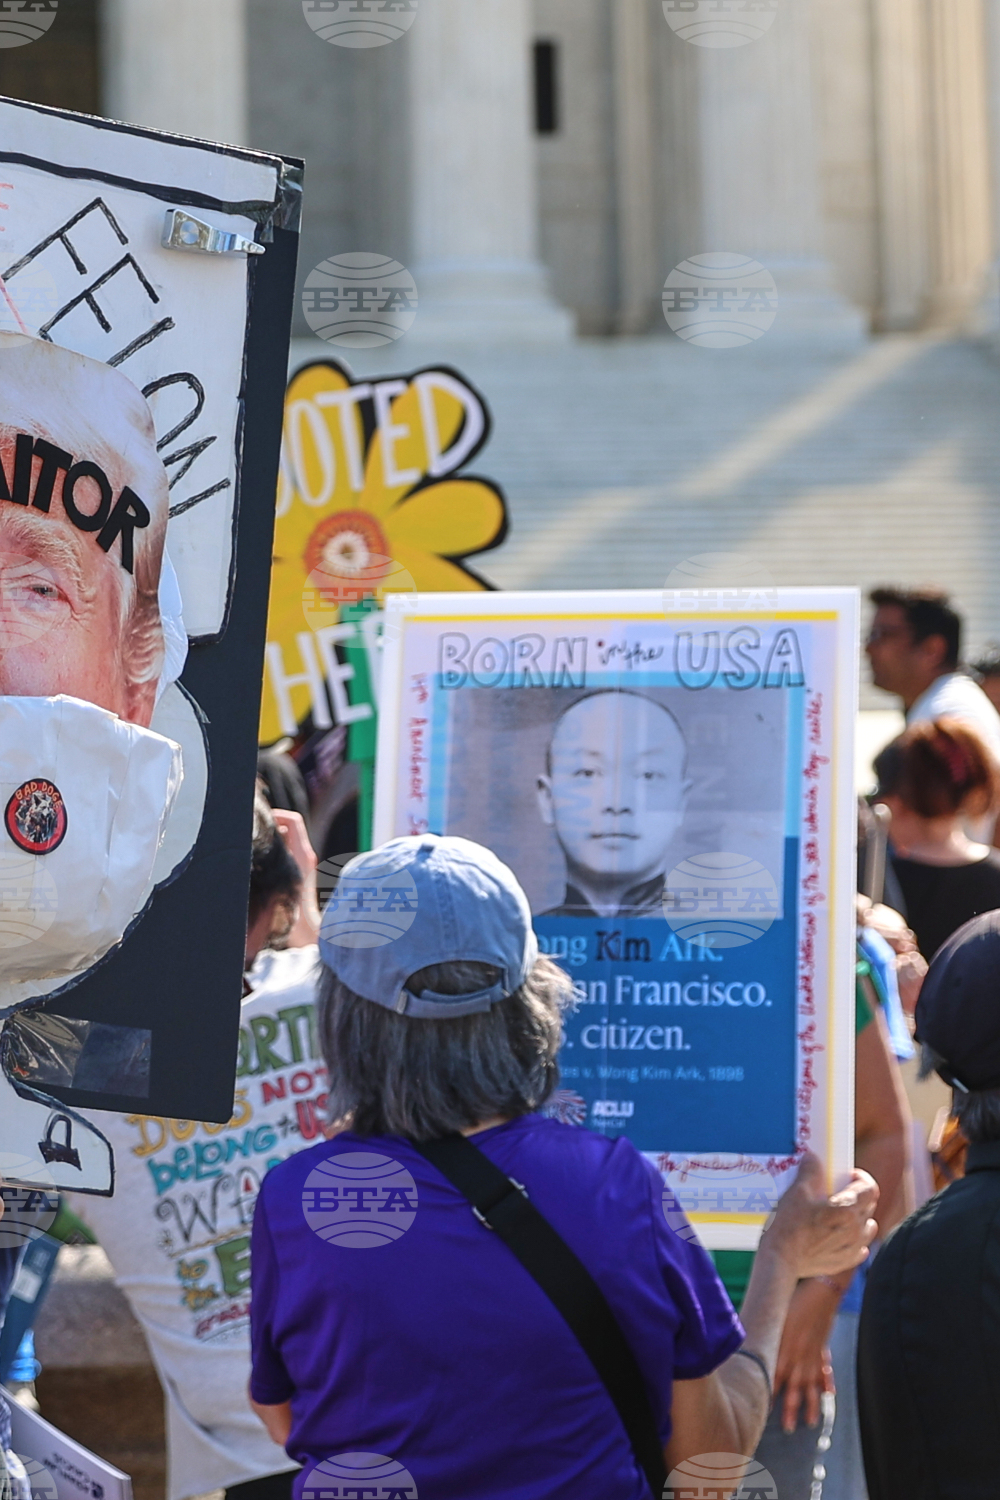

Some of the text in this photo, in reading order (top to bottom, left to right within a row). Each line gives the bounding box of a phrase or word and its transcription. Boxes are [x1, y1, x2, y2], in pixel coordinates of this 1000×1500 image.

[438, 630, 587, 690] BORN
[673, 626, 805, 691] USA
[15, 781, 63, 809] BAD DOGE
[536, 930, 723, 966] ong Kim Ark.
[573, 974, 772, 1007] an Francisco.
[580, 1017, 691, 1051] citizen.
